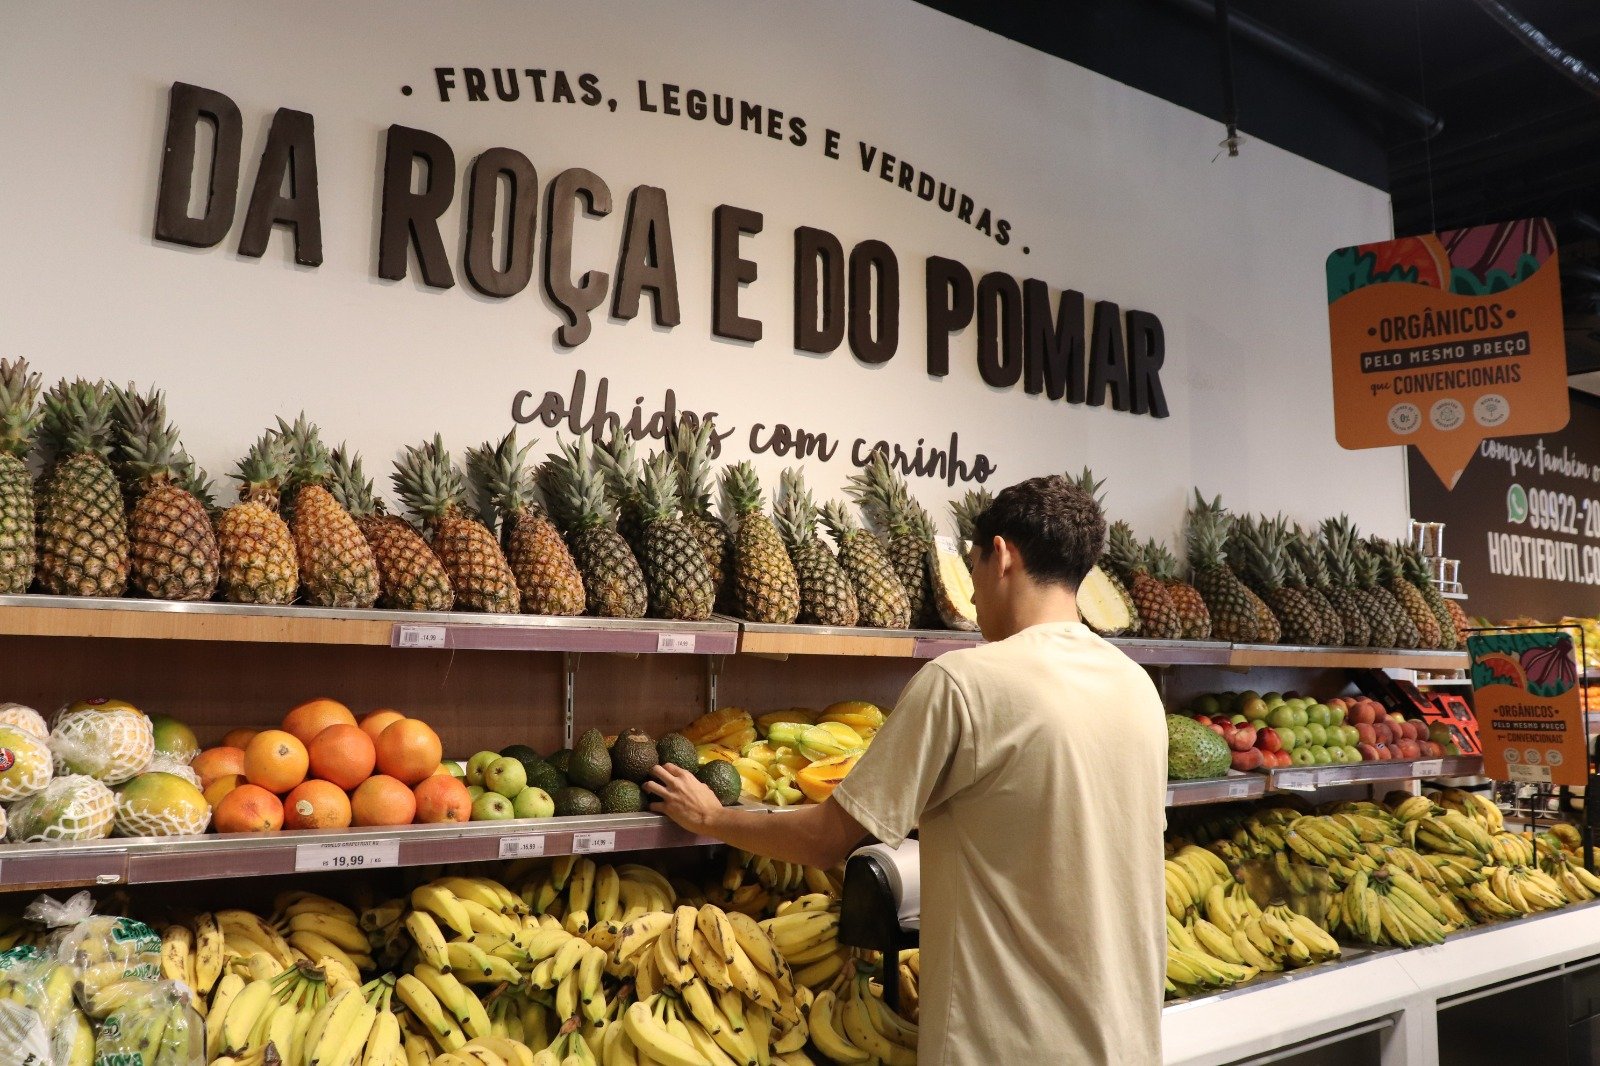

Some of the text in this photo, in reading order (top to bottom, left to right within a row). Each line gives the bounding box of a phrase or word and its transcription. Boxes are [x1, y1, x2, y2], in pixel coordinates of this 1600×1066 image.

[434, 67, 1012, 248] FRUTAS, LEGUMES E VERDURAS
[155, 81, 1169, 419] DA ROÇA E DO POMAR
[1380, 303, 1504, 343] ORGÂNICOS
[1364, 339, 1527, 369] PELO MESMO PREÇO
[1370, 363, 1521, 396] que CONVENCIONAIS
[749, 423, 839, 462] com
[851, 431, 997, 488] carinho
[1481, 439, 1537, 476] compre
[1536, 438, 1591, 479] também
[1499, 703, 1554, 718] ORGÂNICOS
[332, 855, 364, 868] 19,99
